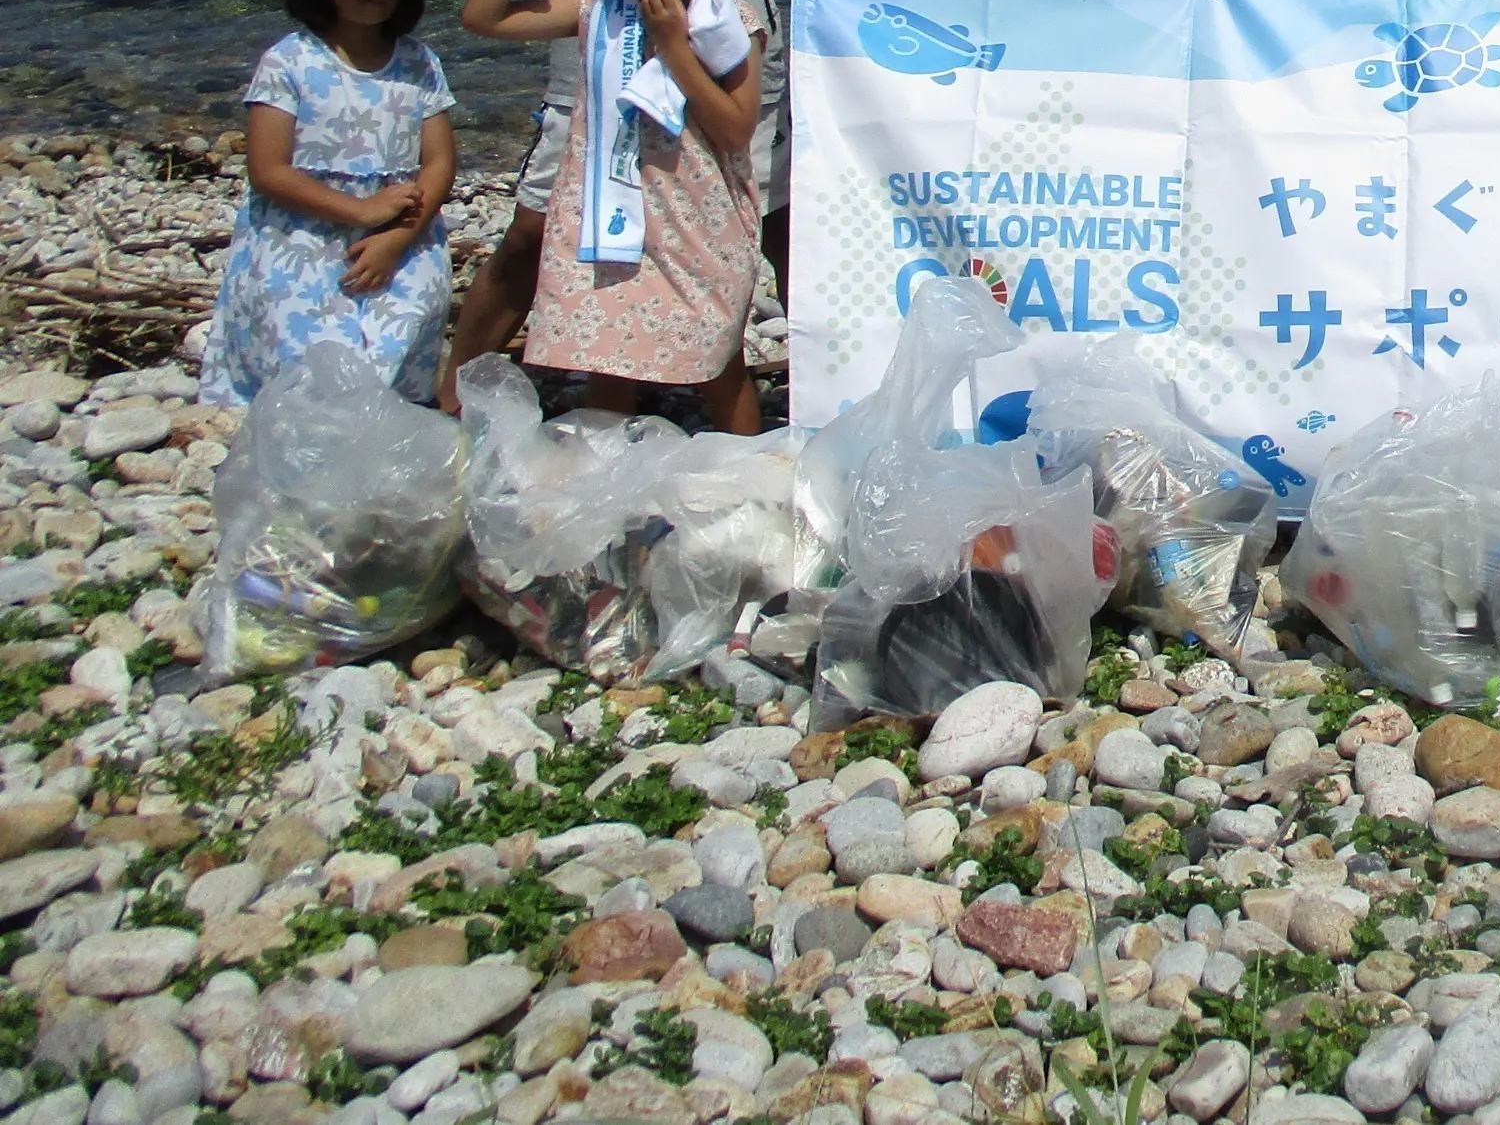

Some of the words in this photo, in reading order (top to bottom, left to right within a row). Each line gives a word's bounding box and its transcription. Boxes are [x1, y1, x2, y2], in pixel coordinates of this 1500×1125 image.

[621, 3, 638, 91] USTAINABLE
[888, 171, 1183, 210] SUSTAINABLE
[893, 215, 1181, 253] DEVELOPMENT
